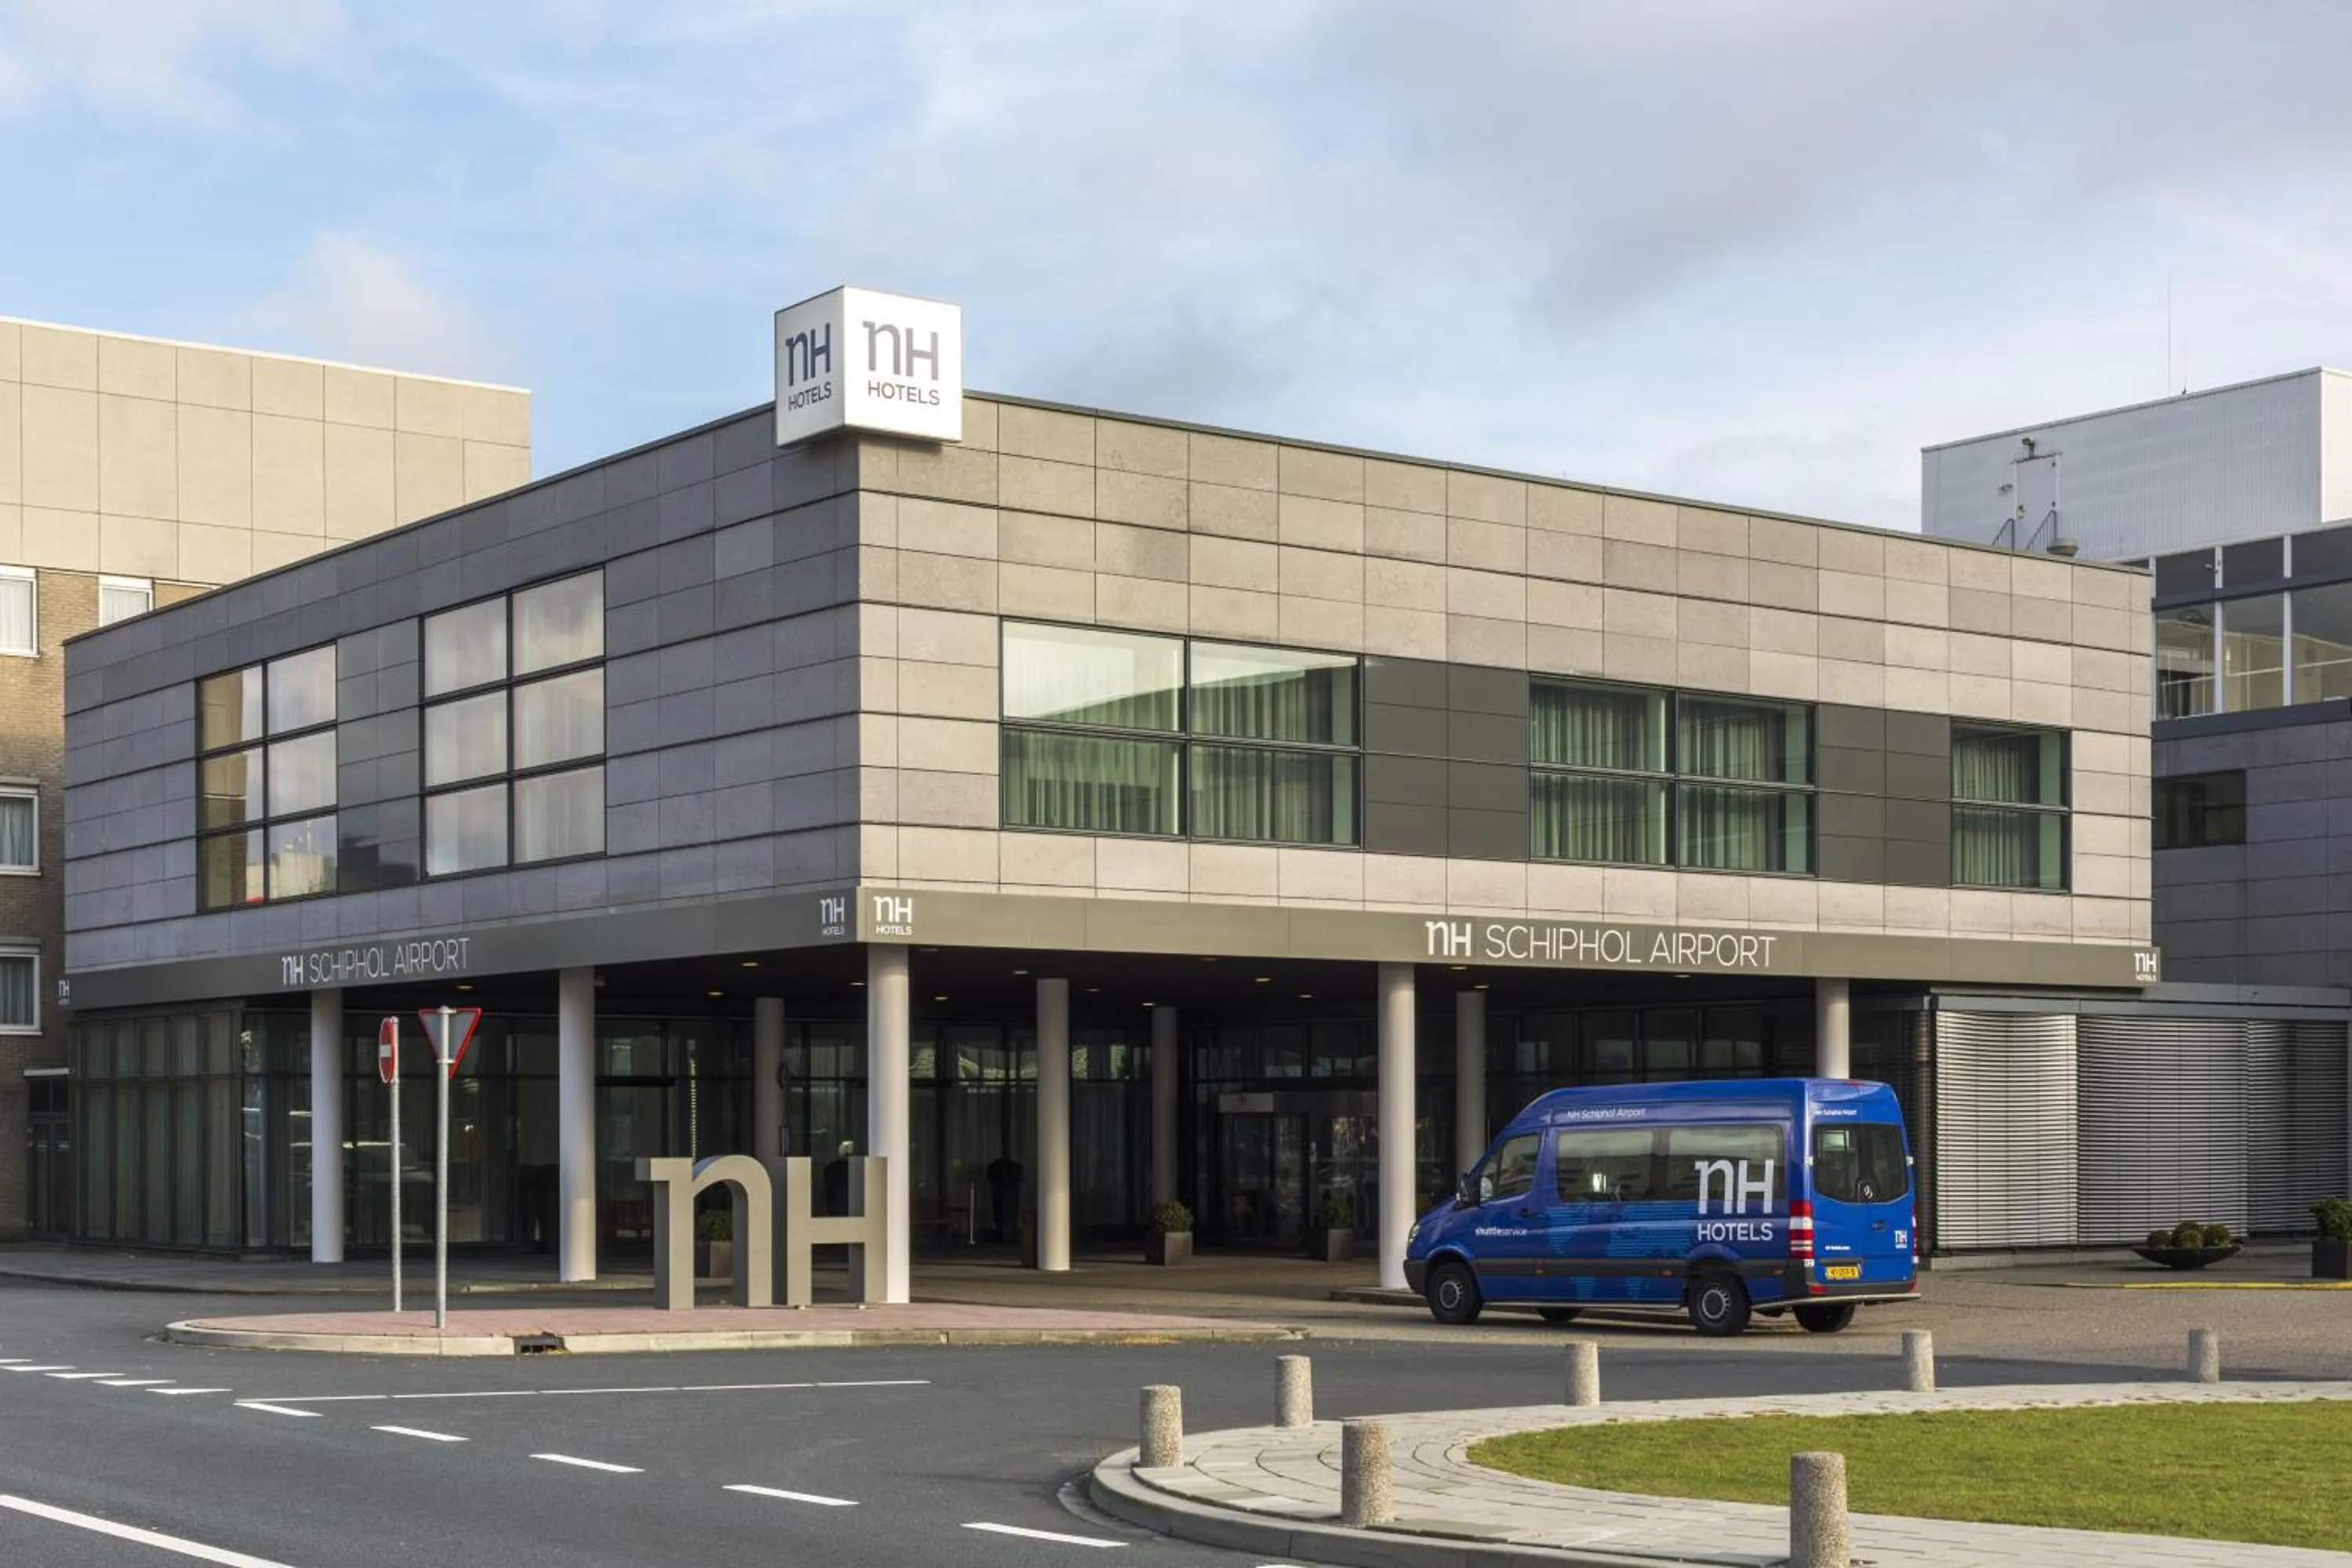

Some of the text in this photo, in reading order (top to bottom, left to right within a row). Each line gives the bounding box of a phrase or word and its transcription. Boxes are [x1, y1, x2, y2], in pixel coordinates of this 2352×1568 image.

[789, 382, 832, 412] HOTELS
[868, 380, 940, 405] HOTELS
[876, 925, 913, 935] HOTELS
[1485, 924, 1642, 964] SCHIPHOL
[1649, 931, 1777, 967] AIRPORT
[310, 946, 390, 983] SCHIPHOL
[393, 937, 470, 975] AIRPORT
[1697, 1222, 1773, 1241] HOTELS
